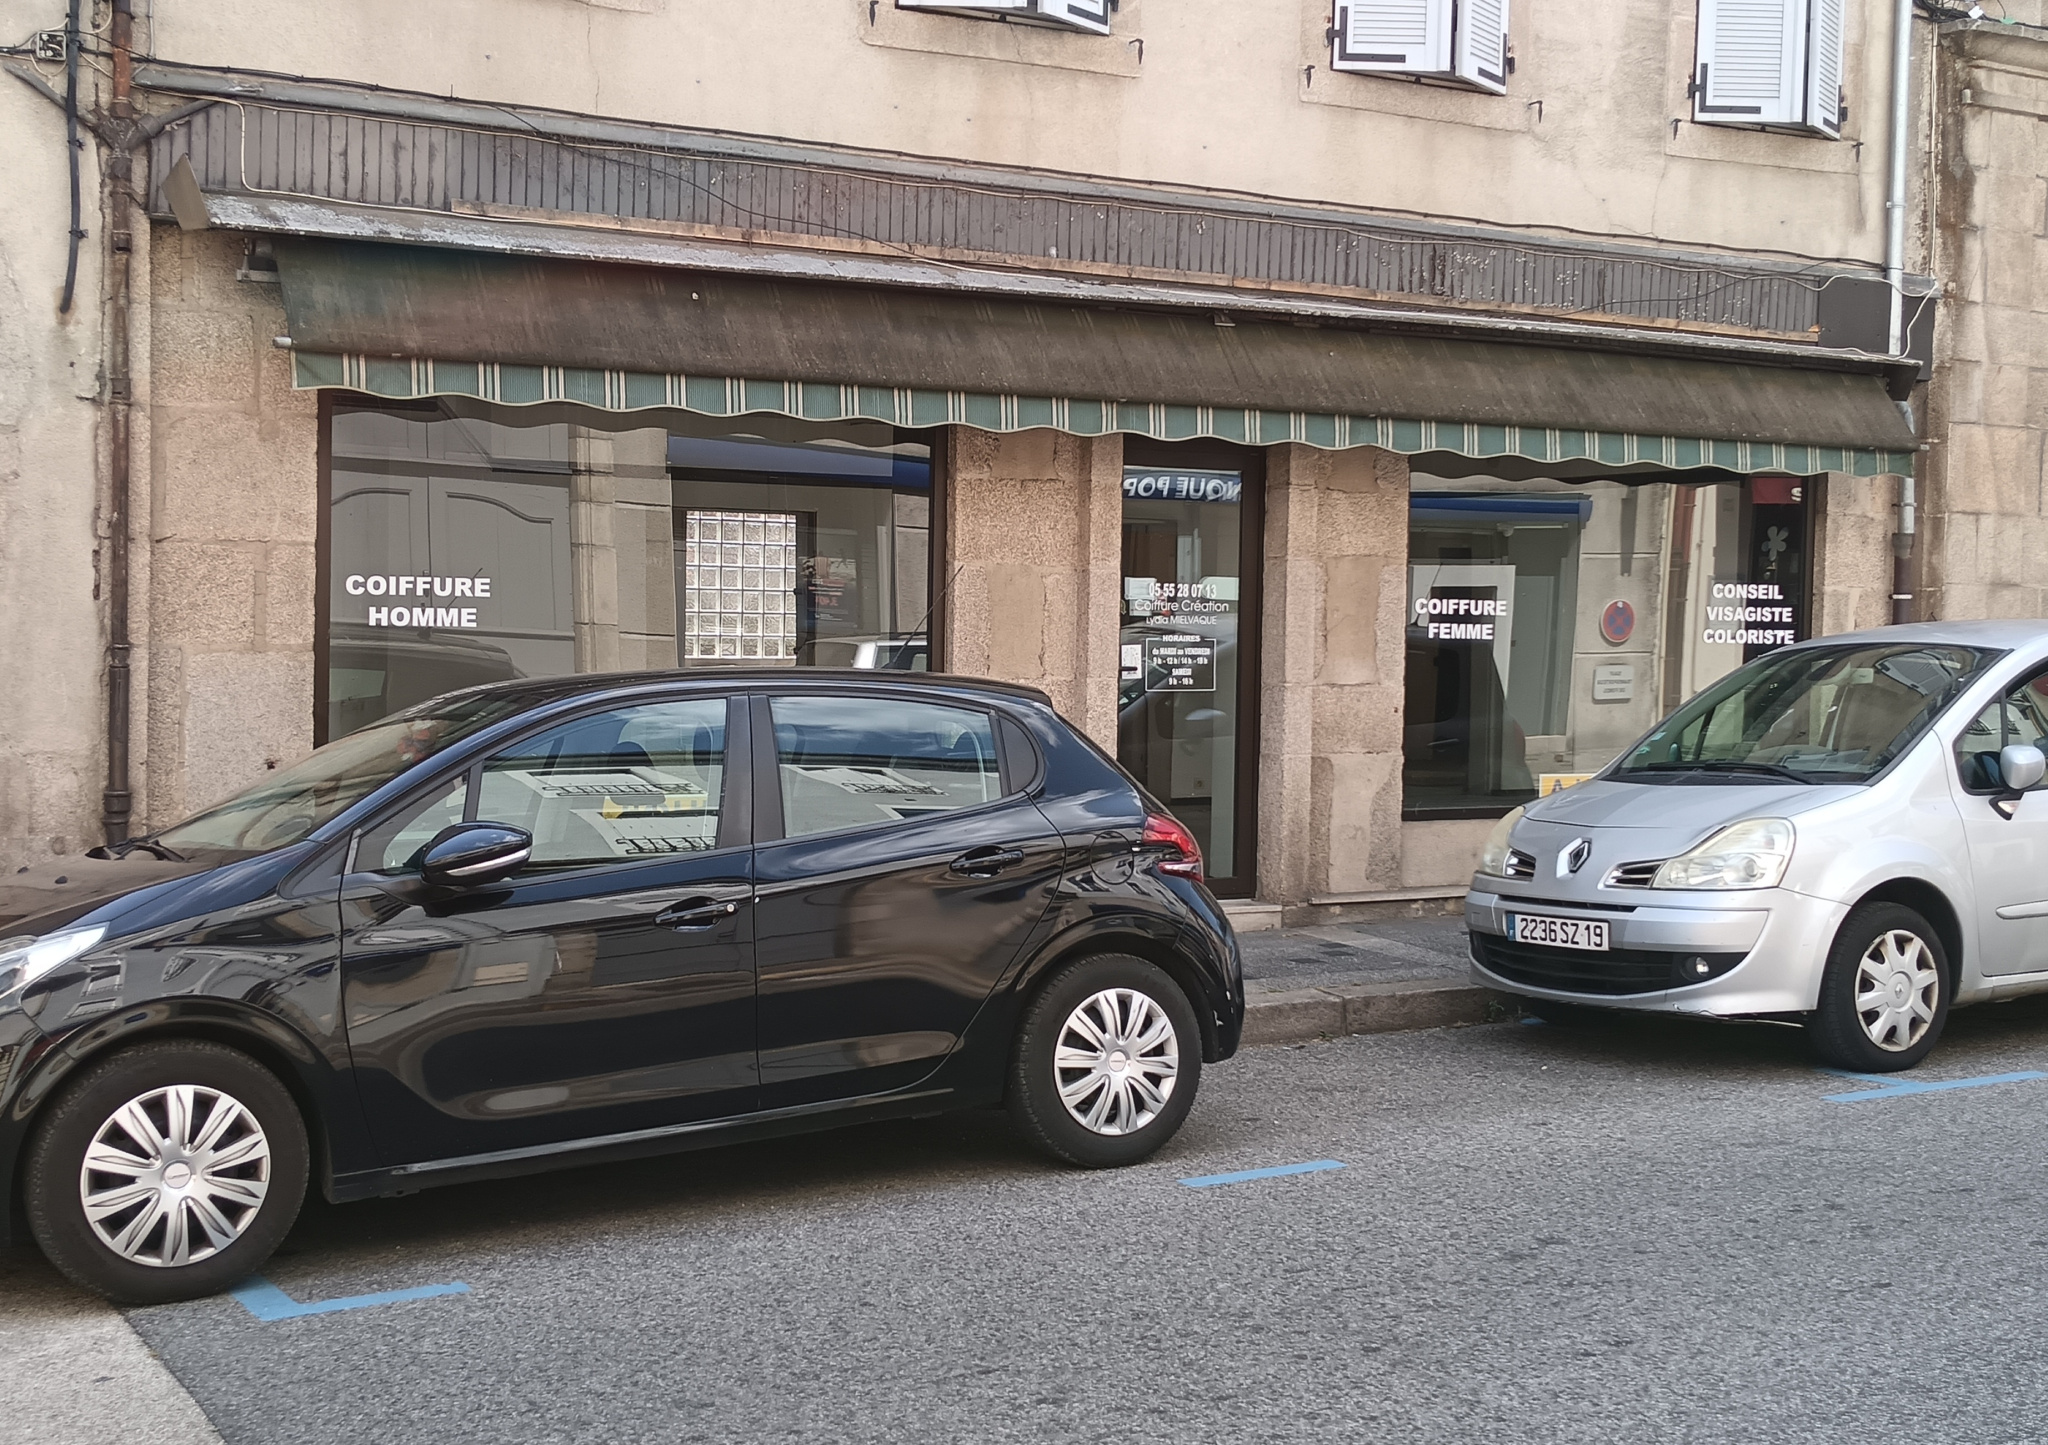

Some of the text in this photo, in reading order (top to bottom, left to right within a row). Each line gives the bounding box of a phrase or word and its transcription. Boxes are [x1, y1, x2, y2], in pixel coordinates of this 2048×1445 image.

[345, 574, 491, 598] COIFFURE
[1148, 583, 1161, 597] 05
[1162, 583, 1176, 597] 55
[1176, 583, 1190, 598] 28
[1190, 584, 1204, 598] 07
[1204, 584, 1218, 599] 13
[1712, 583, 1784, 600] CONSEIL
[1134, 599, 1229, 612] Coiffure Création
[1414, 598, 1507, 616] COIFFURE
[368, 606, 478, 628] HOMME
[1146, 615, 1218, 625] Lydia MIELVAQUE
[1706, 606, 1793, 623] VISAGISTE
[1162, 634, 1201, 642] HORAIRES
[1427, 622, 1494, 640] FEMME
[1703, 629, 1795, 645] COLORISTE
[1160, 647, 1177, 655] MARDI
[1184, 647, 1211, 655] VENDREDI
[1172, 668, 1192, 676] SAMEDI
[1520, 918, 1603, 948] 2236 SZ 19
